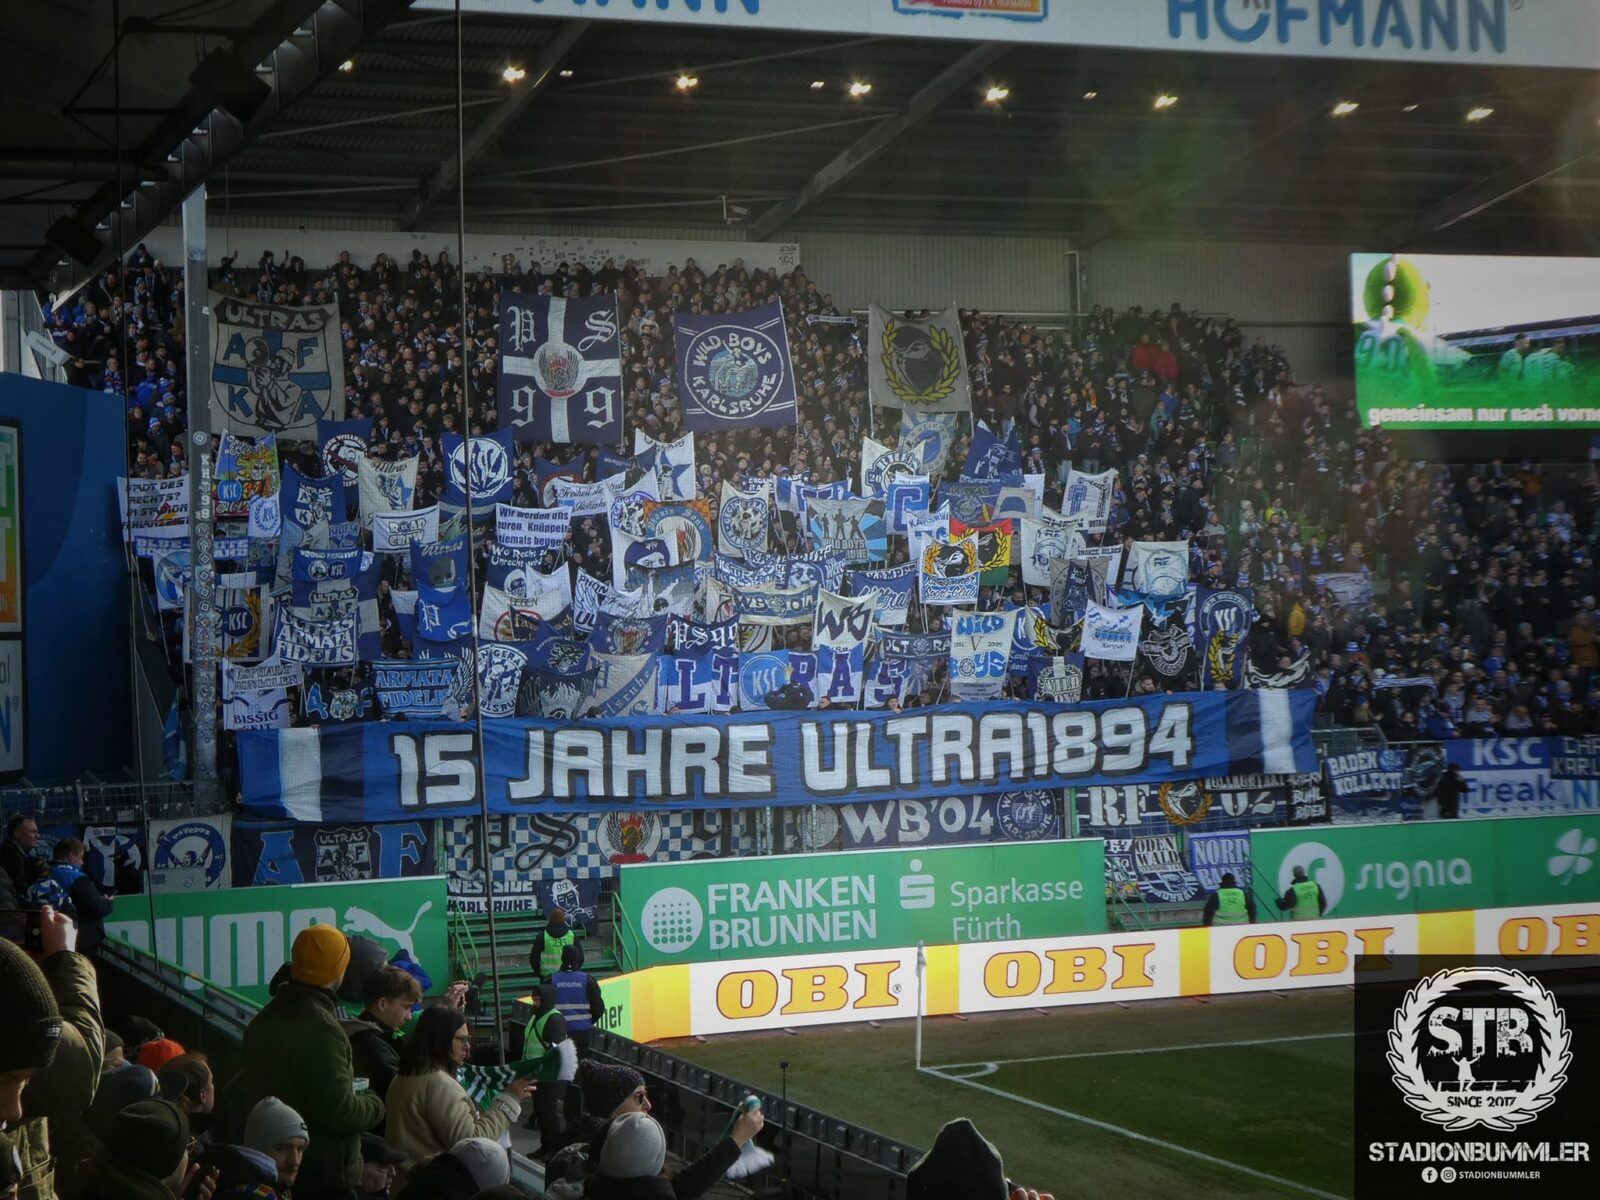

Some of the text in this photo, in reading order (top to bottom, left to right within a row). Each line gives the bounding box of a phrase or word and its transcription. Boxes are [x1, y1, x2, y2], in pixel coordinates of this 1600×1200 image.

[224, 304, 326, 331] ULTRAS
[692, 332, 773, 368] WILD BOYS
[691, 372, 777, 415] KARLSRUHE
[1368, 403, 1473, 426] gemeinsam
[1477, 407, 1508, 422] nur
[1511, 404, 1554, 422] nach
[160, 479, 184, 490] DES
[500, 507, 514, 518] Wir
[517, 510, 550, 520] werden
[491, 545, 510, 556] Wo
[313, 590, 355, 603] ULTRAS
[229, 613, 248, 631] KSC
[375, 669, 453, 688] ARMATA
[752, 666, 780, 697] KSC
[234, 711, 279, 725] BISSIG
[394, 704, 1192, 805] 15 JAHRE ULTRA1894
[1327, 751, 1379, 776] BADEN
[1472, 737, 1544, 766] KSC
[1461, 774, 1558, 804] Freak
[320, 831, 364, 845] ULTRAS
[1194, 838, 1250, 865] NORD
[1136, 850, 1180, 866] WALD
[1354, 858, 1473, 900] signia
[707, 875, 876, 914] FRANKEN
[950, 877, 1083, 912] Sparkasse
[708, 909, 878, 951] BRUNNEN
[951, 914, 1022, 942] Fürth
[1232, 927, 1395, 980] OBI
[983, 943, 1156, 998] OBI
[716, 960, 901, 1019] OBI
